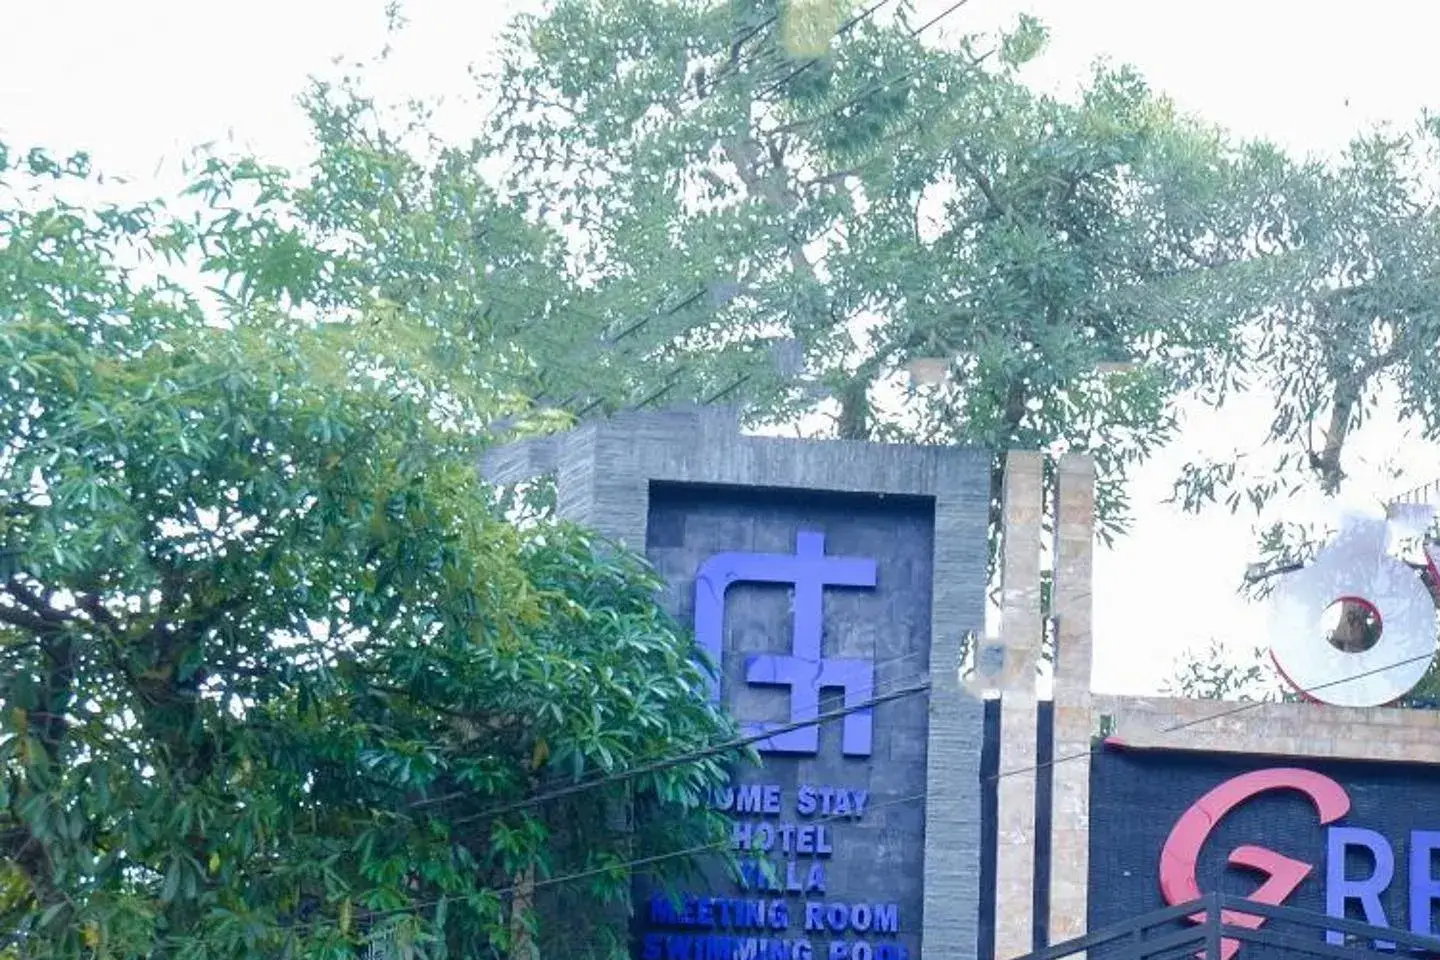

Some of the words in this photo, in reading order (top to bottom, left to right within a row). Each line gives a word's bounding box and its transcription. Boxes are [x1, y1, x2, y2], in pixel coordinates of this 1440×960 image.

[705, 784, 780, 813] OME
[798, 785, 867, 818] STAY
[732, 822, 832, 855] HOTEL
[651, 896, 788, 930] MEETING
[805, 901, 898, 932] ROOM
